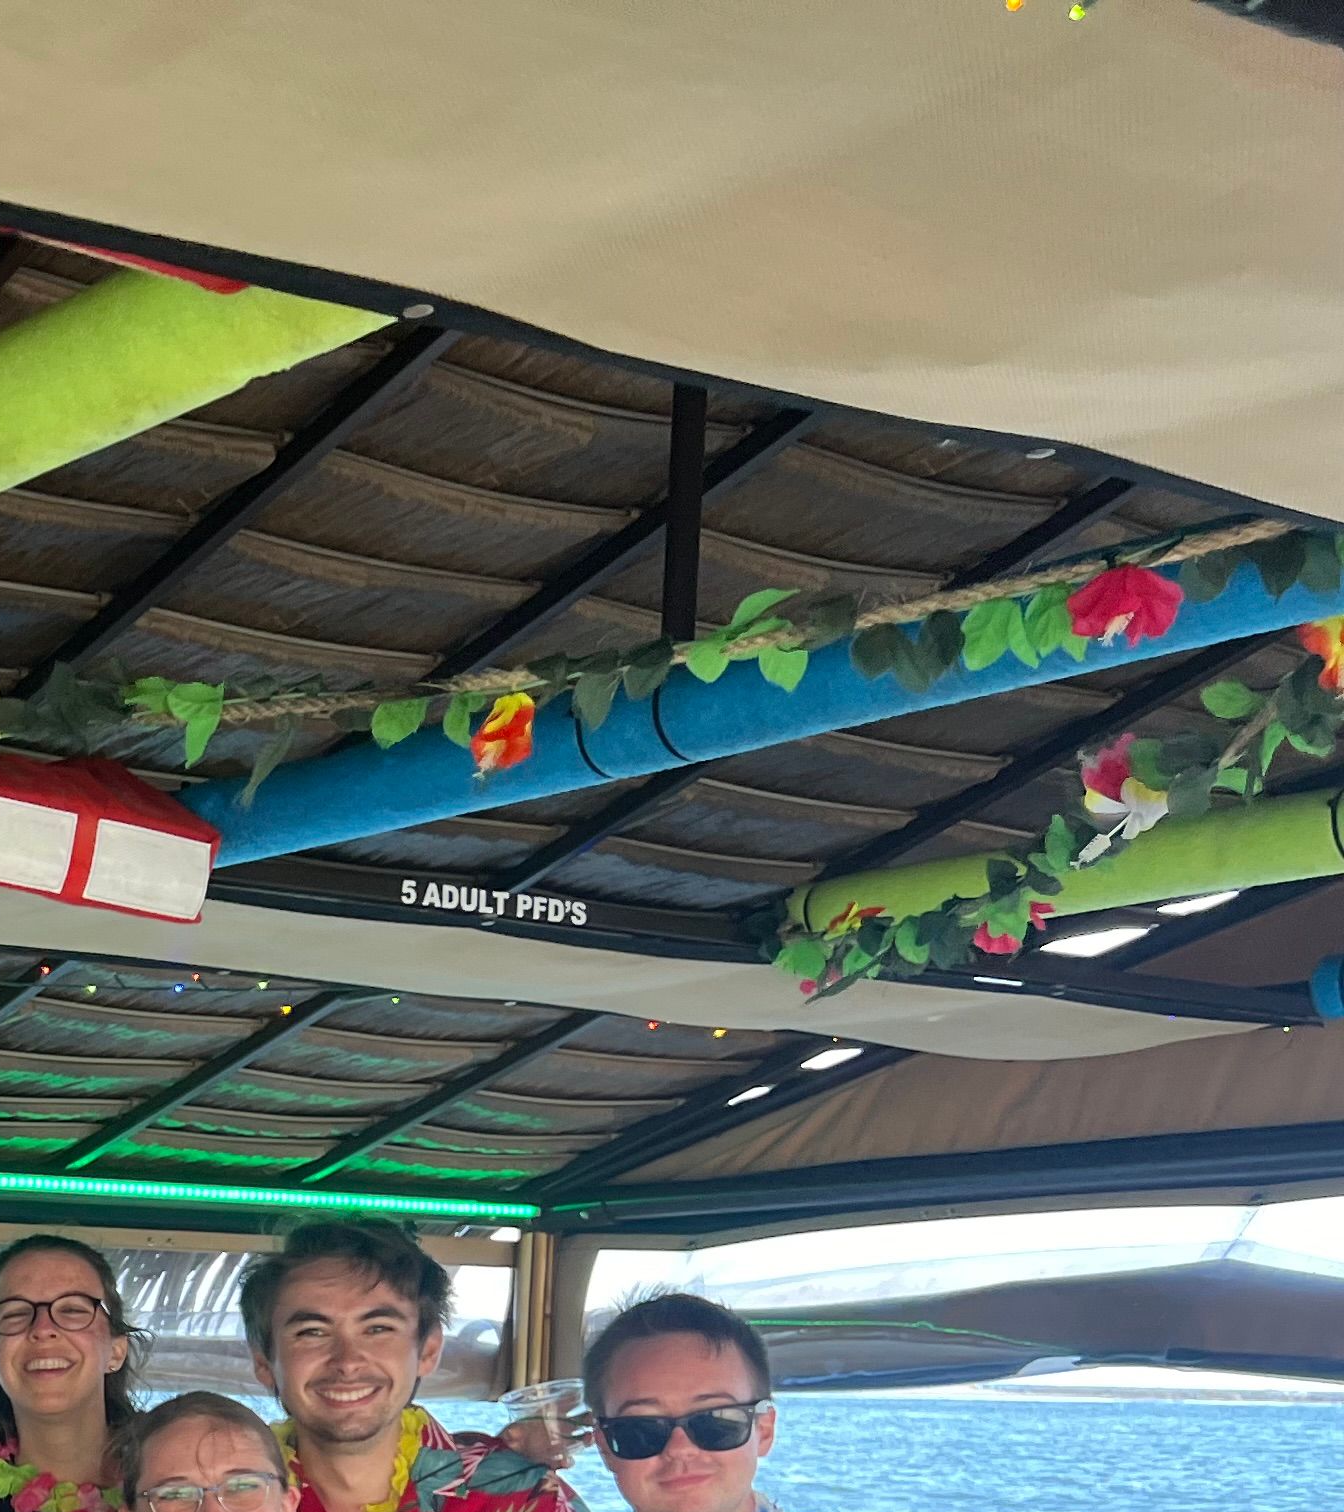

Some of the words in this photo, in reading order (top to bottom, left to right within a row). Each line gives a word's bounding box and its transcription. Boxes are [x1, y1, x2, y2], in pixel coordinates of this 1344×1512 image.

[400, 879, 418, 905] 5
[421, 882, 510, 916] ADULT
[516, 893, 588, 926] PFD'S
